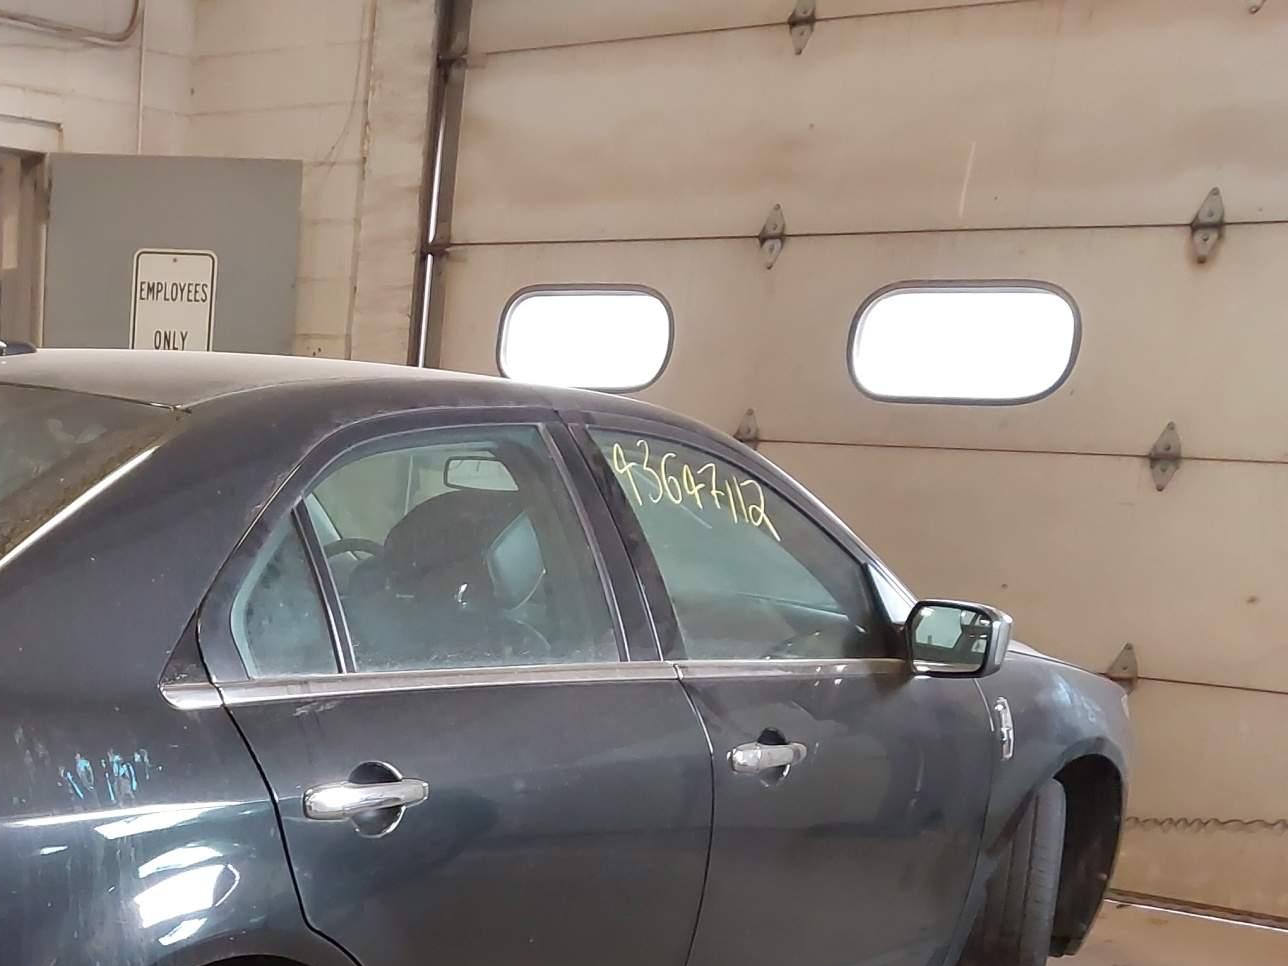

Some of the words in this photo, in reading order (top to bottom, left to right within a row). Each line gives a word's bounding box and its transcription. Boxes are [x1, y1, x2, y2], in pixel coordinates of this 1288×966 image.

[139, 281, 208, 302] EMPLOYEES
[154, 330, 188, 351] ONLY
[613, 440, 781, 542] 43647112
